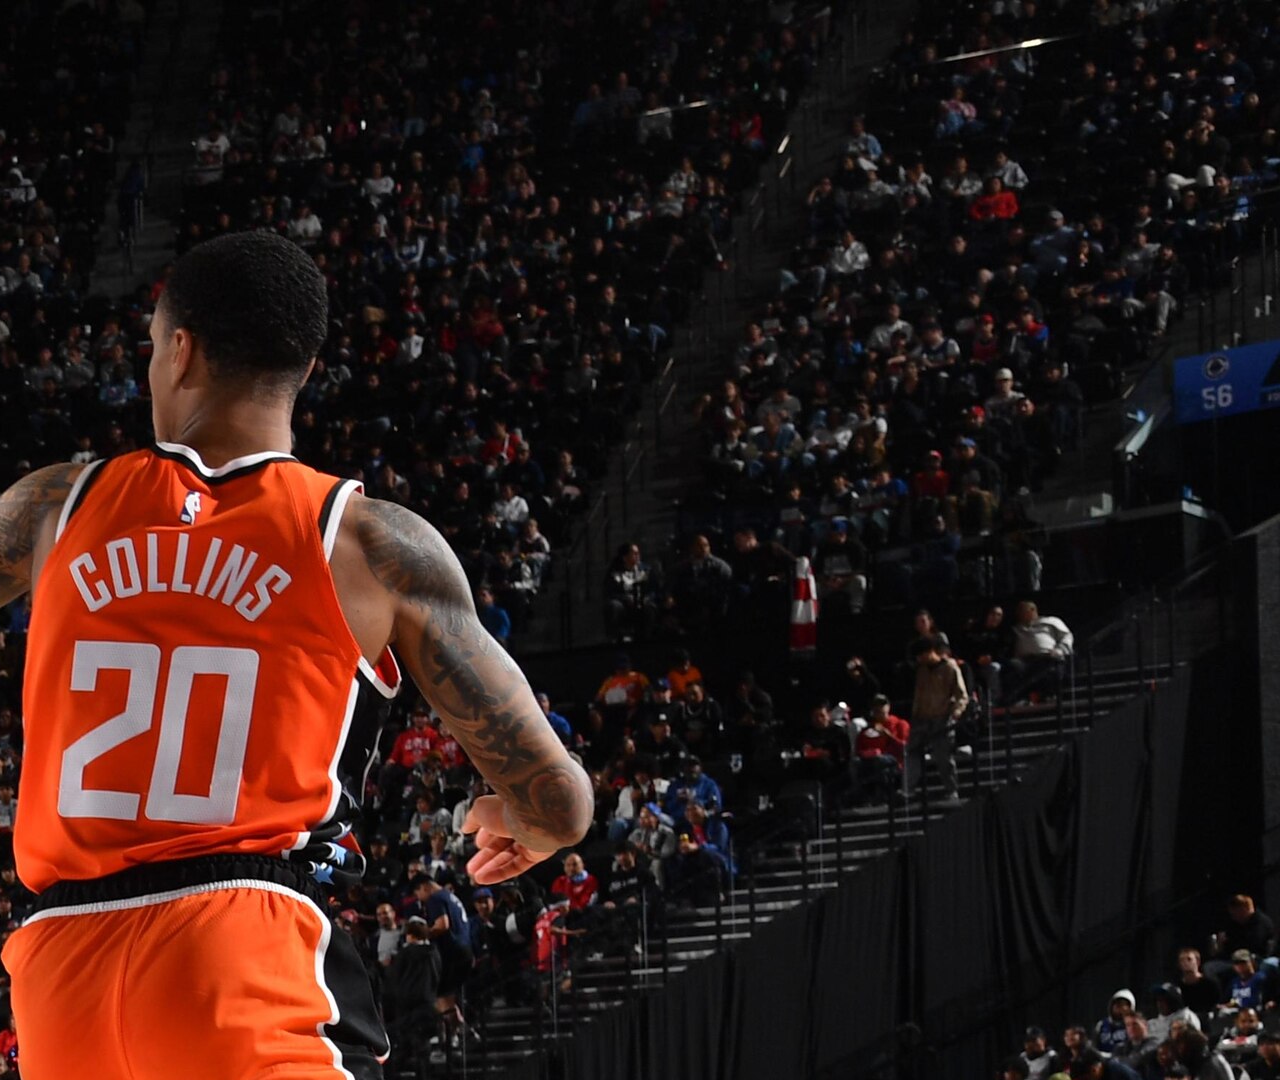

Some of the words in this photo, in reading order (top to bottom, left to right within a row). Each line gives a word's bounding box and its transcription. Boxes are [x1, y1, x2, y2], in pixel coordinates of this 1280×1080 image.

[1202, 385, 1232, 410] 56
[68, 532, 292, 622] COLLINS
[57, 640, 260, 826] 20
